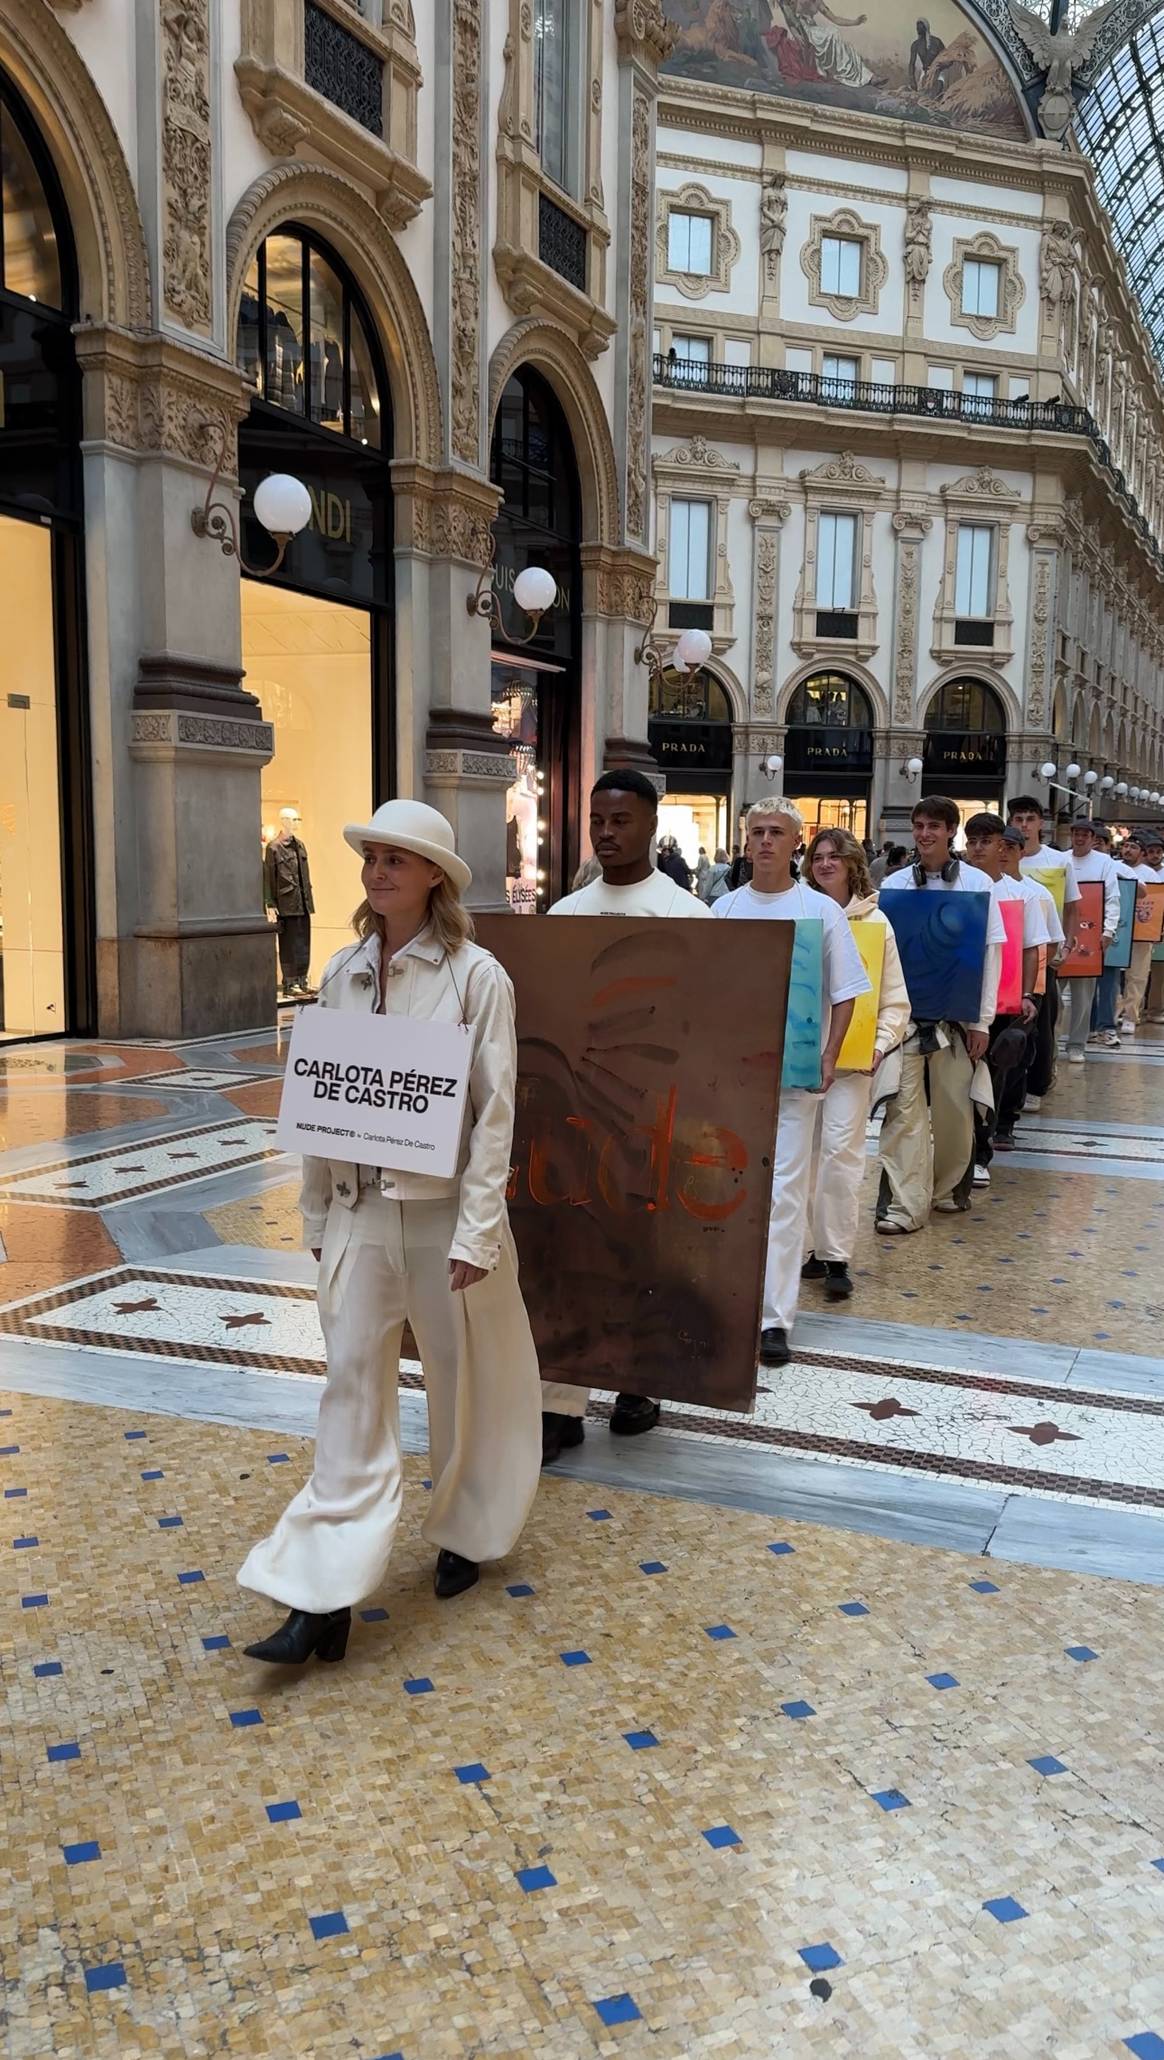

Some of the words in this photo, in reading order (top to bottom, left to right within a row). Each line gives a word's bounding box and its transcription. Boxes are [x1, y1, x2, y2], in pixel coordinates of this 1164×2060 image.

[307, 484, 351, 543] NDI
[492, 563, 516, 592] UIS
[662, 742, 706, 752] PRADA
[807, 747, 848, 757] PRADA
[943, 751, 982, 760] PRADA
[294, 1058, 384, 1087] CARLOTA
[389, 1069, 458, 1097] PÉREZ
[313, 1080, 341, 1101] DE
[345, 1085, 428, 1113] CASTRO
[296, 1122, 316, 1132] NUDE
[415, 1140, 436, 1151] Castro
[506, 1086, 748, 1221] ude
